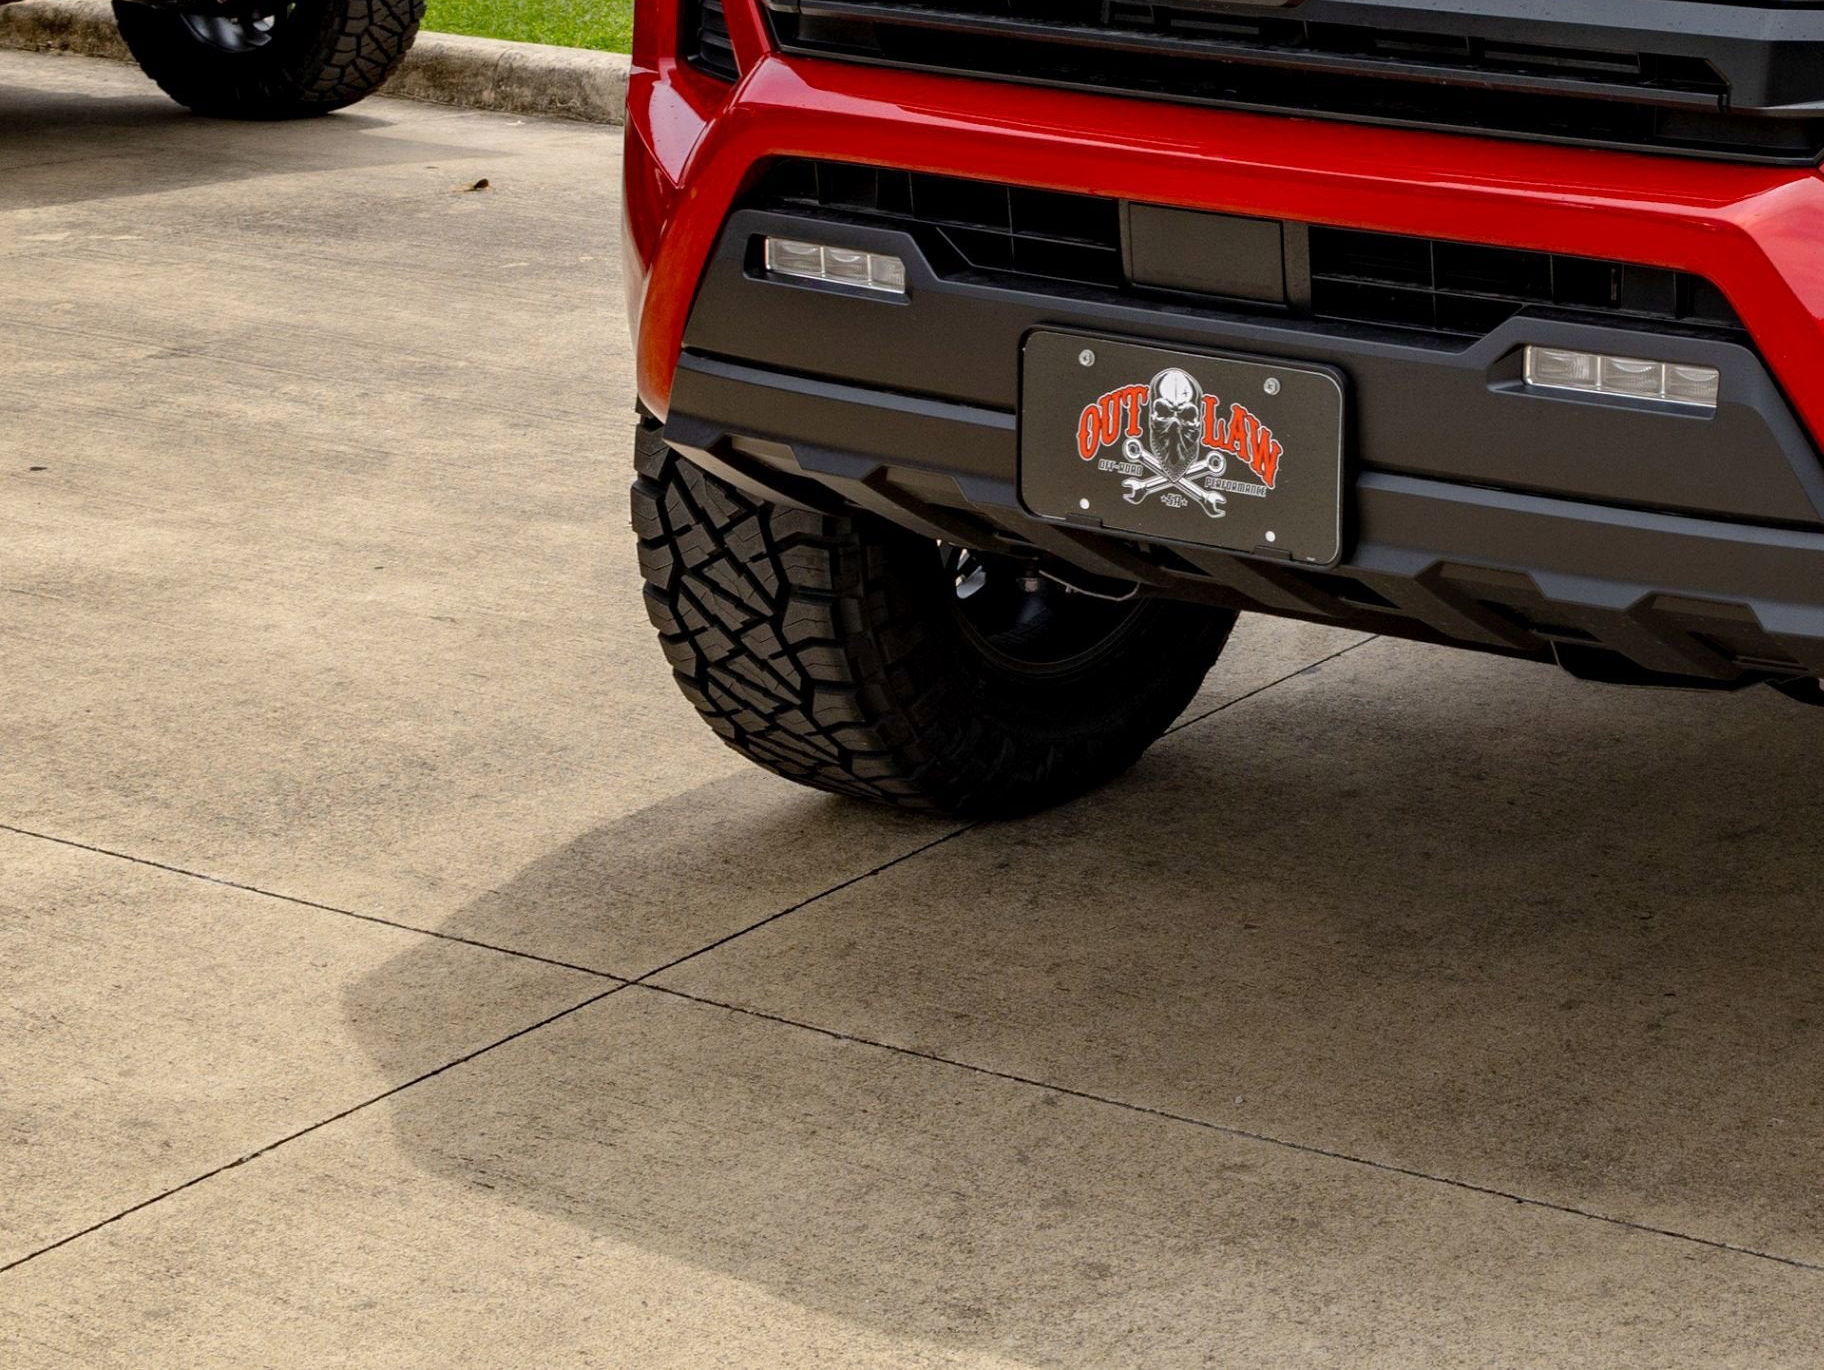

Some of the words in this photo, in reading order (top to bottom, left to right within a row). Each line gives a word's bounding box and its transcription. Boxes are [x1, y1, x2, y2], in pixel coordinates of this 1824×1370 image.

[1076, 383, 1150, 461] OUT
[1201, 393, 1284, 489] LAW
[1098, 458, 1143, 477] OFF-ROAD
[1204, 476, 1268, 498] PERFORMANCE
